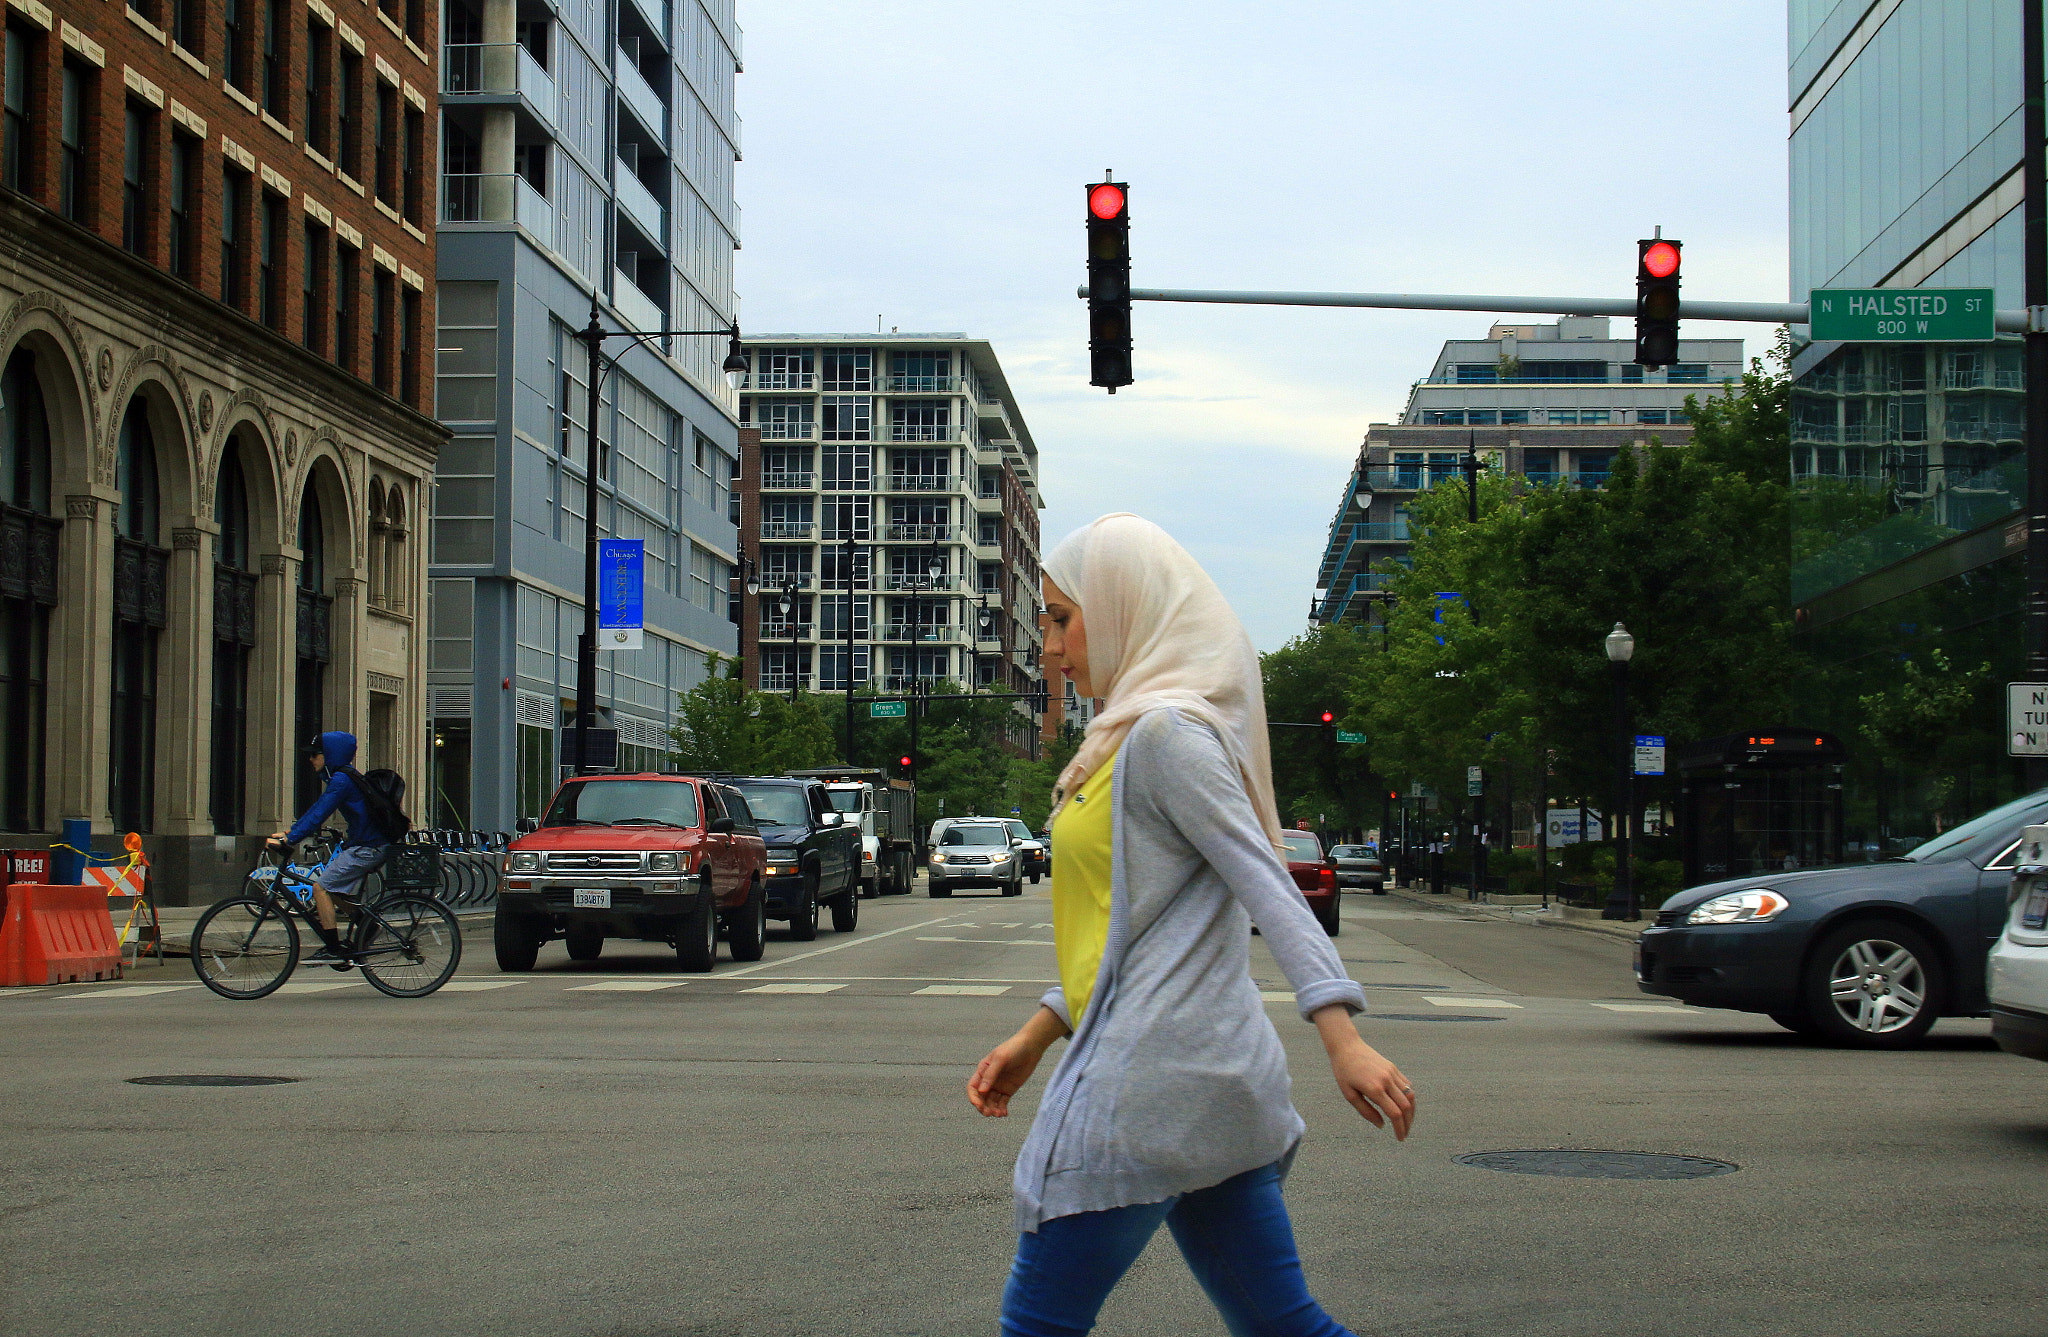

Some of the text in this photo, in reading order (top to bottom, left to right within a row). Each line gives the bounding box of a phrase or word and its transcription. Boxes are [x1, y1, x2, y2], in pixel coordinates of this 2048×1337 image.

[1822, 296, 1982, 316] N HALSTED ST
[1877, 320, 1929, 334] 800 W
[2032, 691, 2048, 705] N
[2024, 711, 2048, 725] TU
[2015, 732, 2037, 746] N
